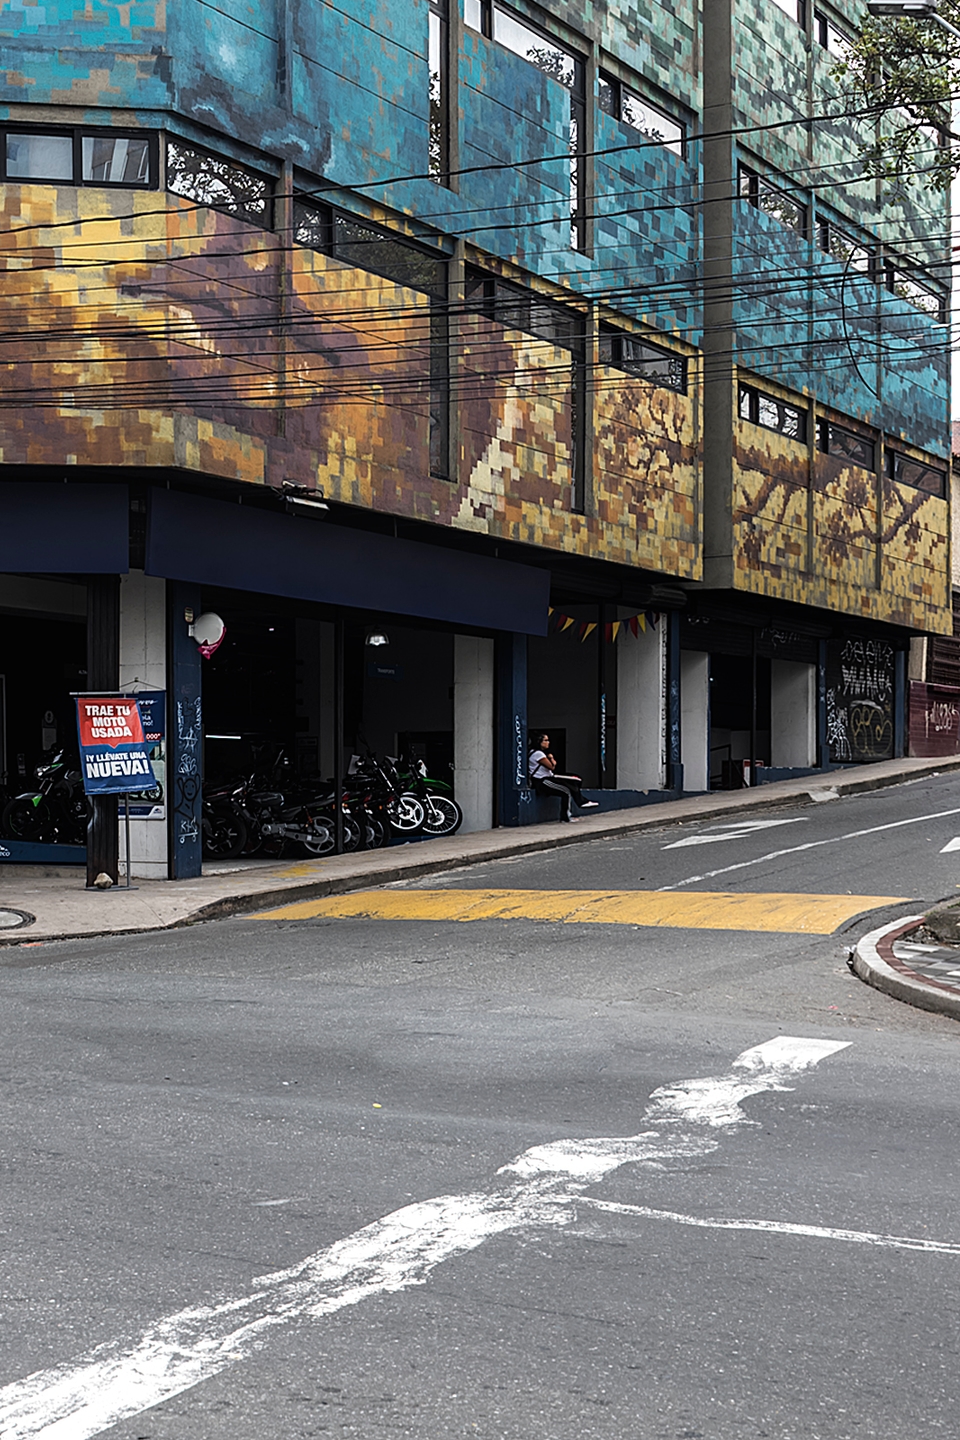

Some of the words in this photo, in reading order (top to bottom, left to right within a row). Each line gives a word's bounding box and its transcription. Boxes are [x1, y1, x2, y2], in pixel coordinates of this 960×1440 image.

[85, 705, 113, 716] TRAE
[115, 705, 131, 716] TU
[93, 717, 127, 728] MOTO
[91, 726, 133, 738] USADA
[96, 751, 128, 762] LLÉVATE
[129, 751, 147, 760] UNA
[86, 759, 150, 778] NUEVA!
